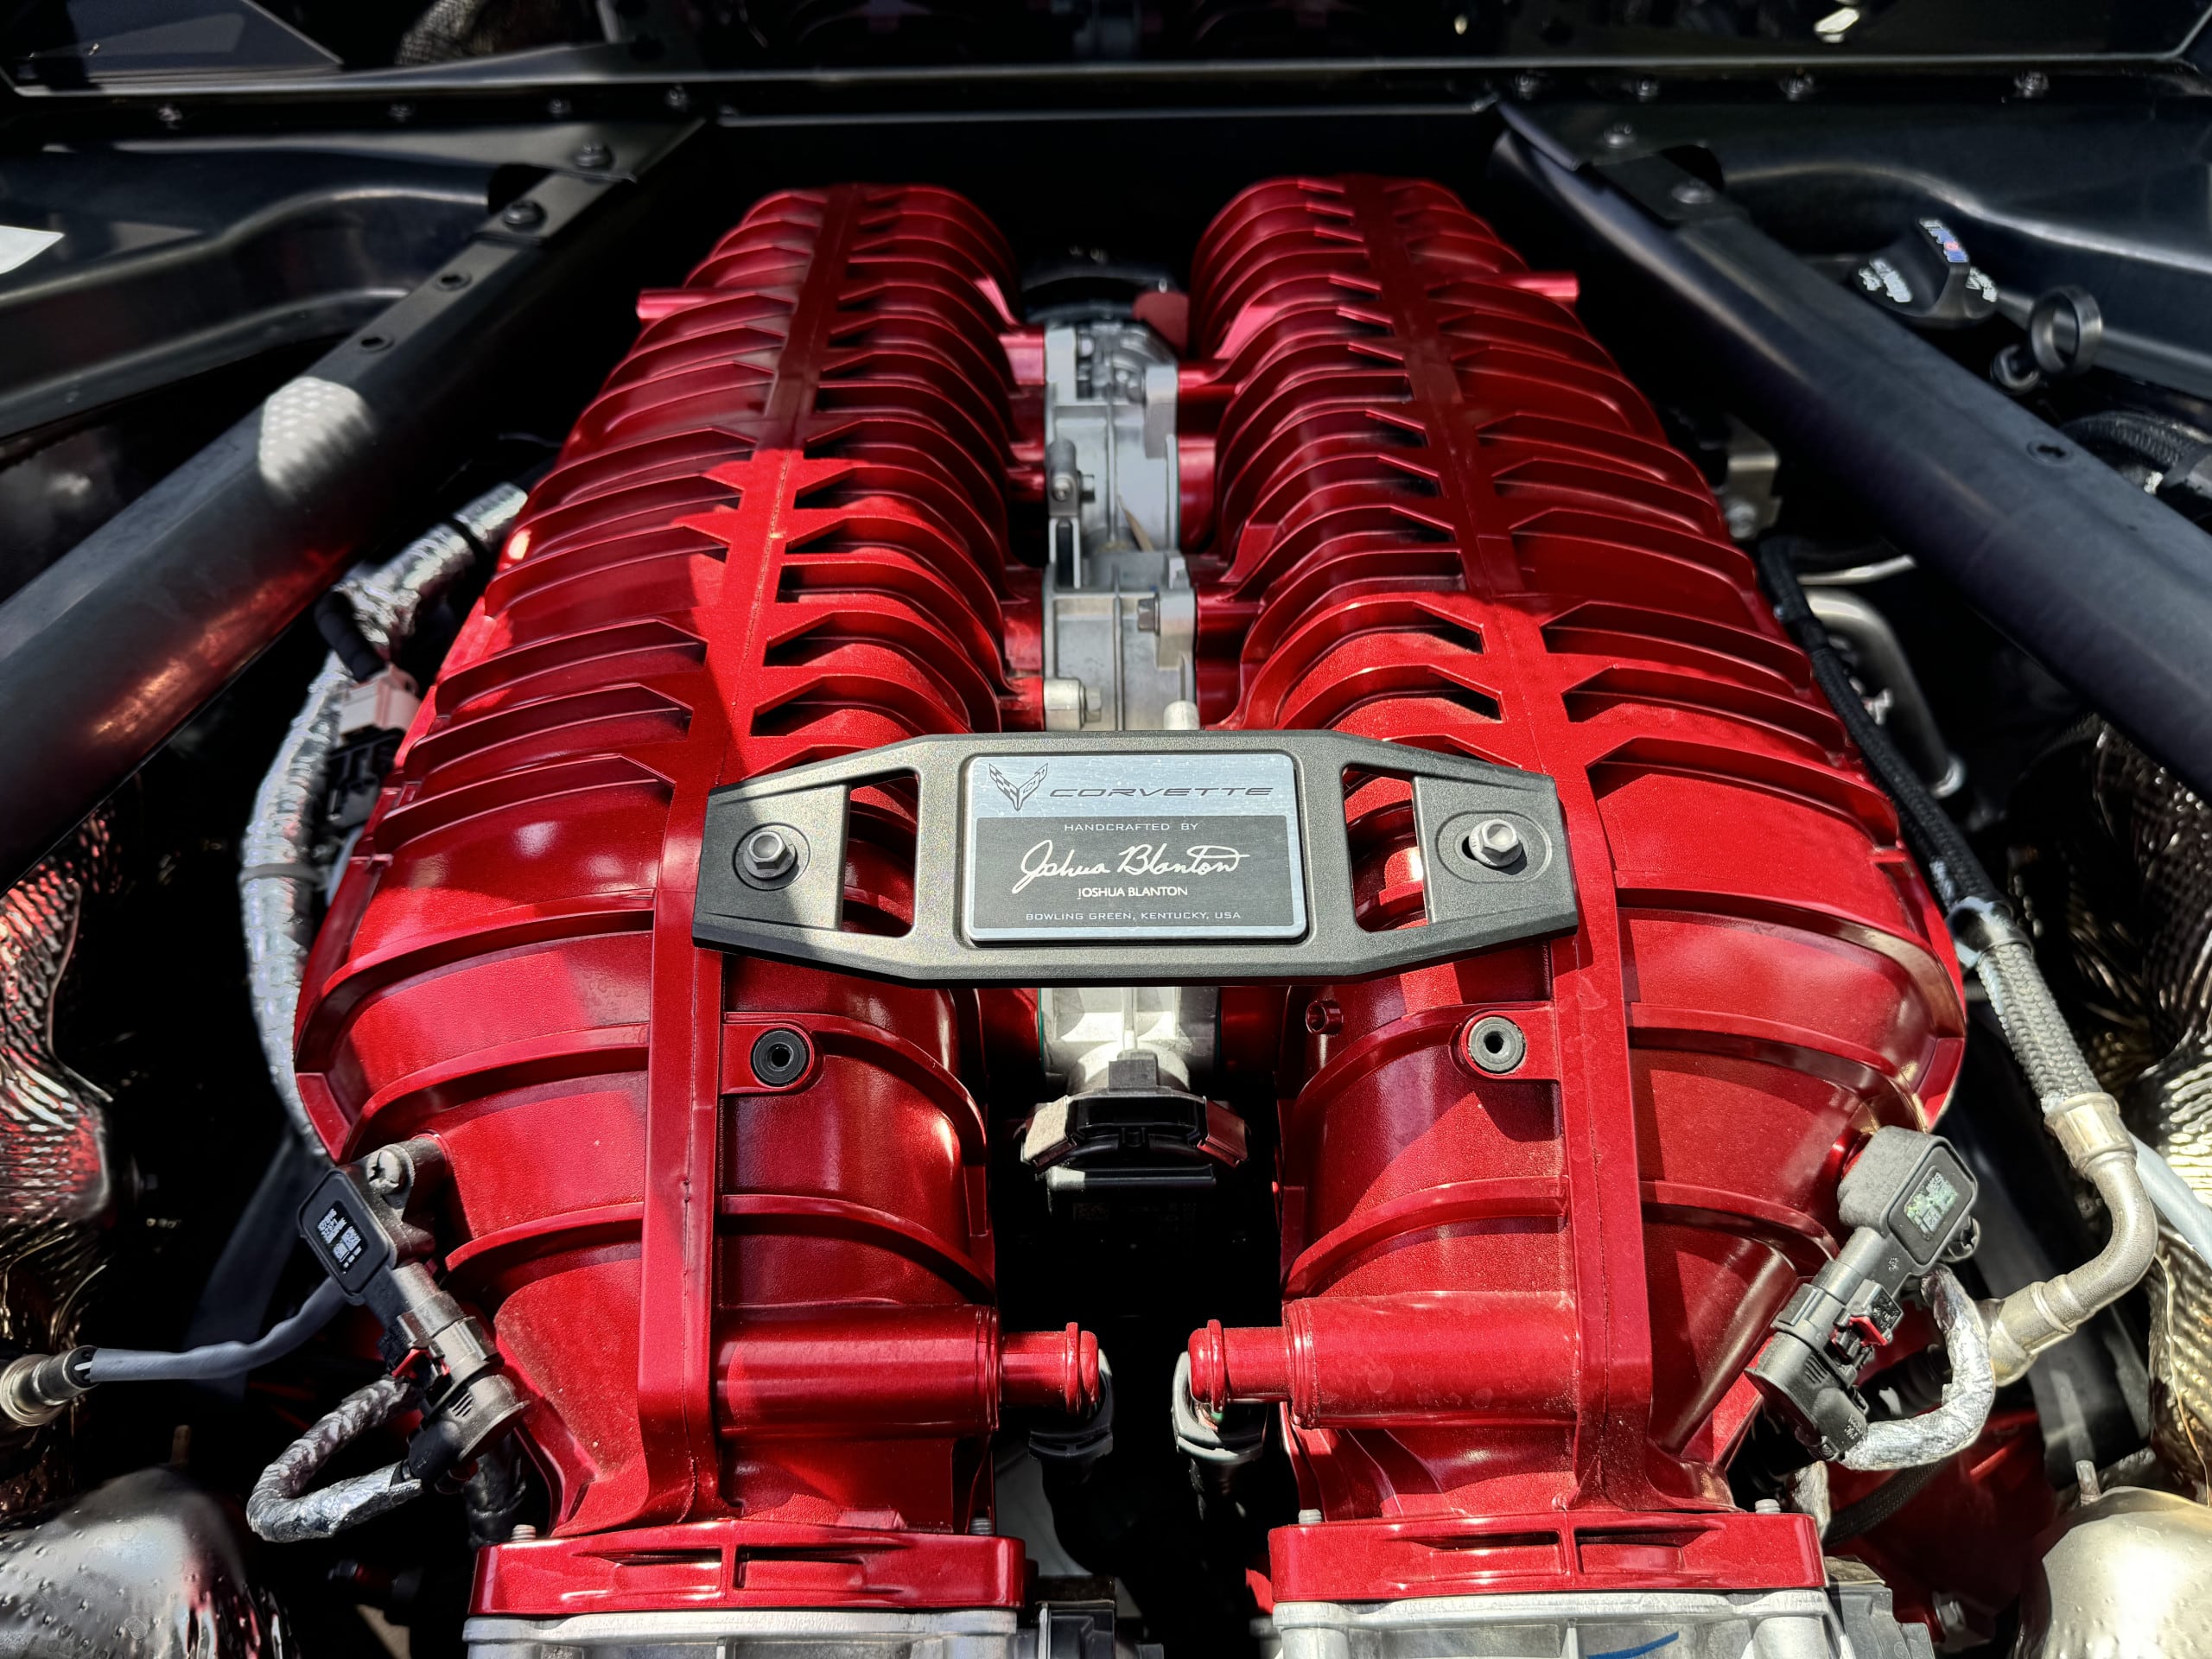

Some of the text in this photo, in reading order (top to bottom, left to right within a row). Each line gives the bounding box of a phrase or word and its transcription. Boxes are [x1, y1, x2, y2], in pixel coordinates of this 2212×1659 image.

[1049, 787, 1274, 798] CORVETTE
[1064, 823, 1199, 832] HANDCRAFTED BY
[1077, 887, 1188, 899] JOSHUA BLANTON
[1026, 912, 1084, 921] BOWLING
[1089, 912, 1136, 921] GREEN,
[1141, 912, 1210, 920] KENTUCKY,
